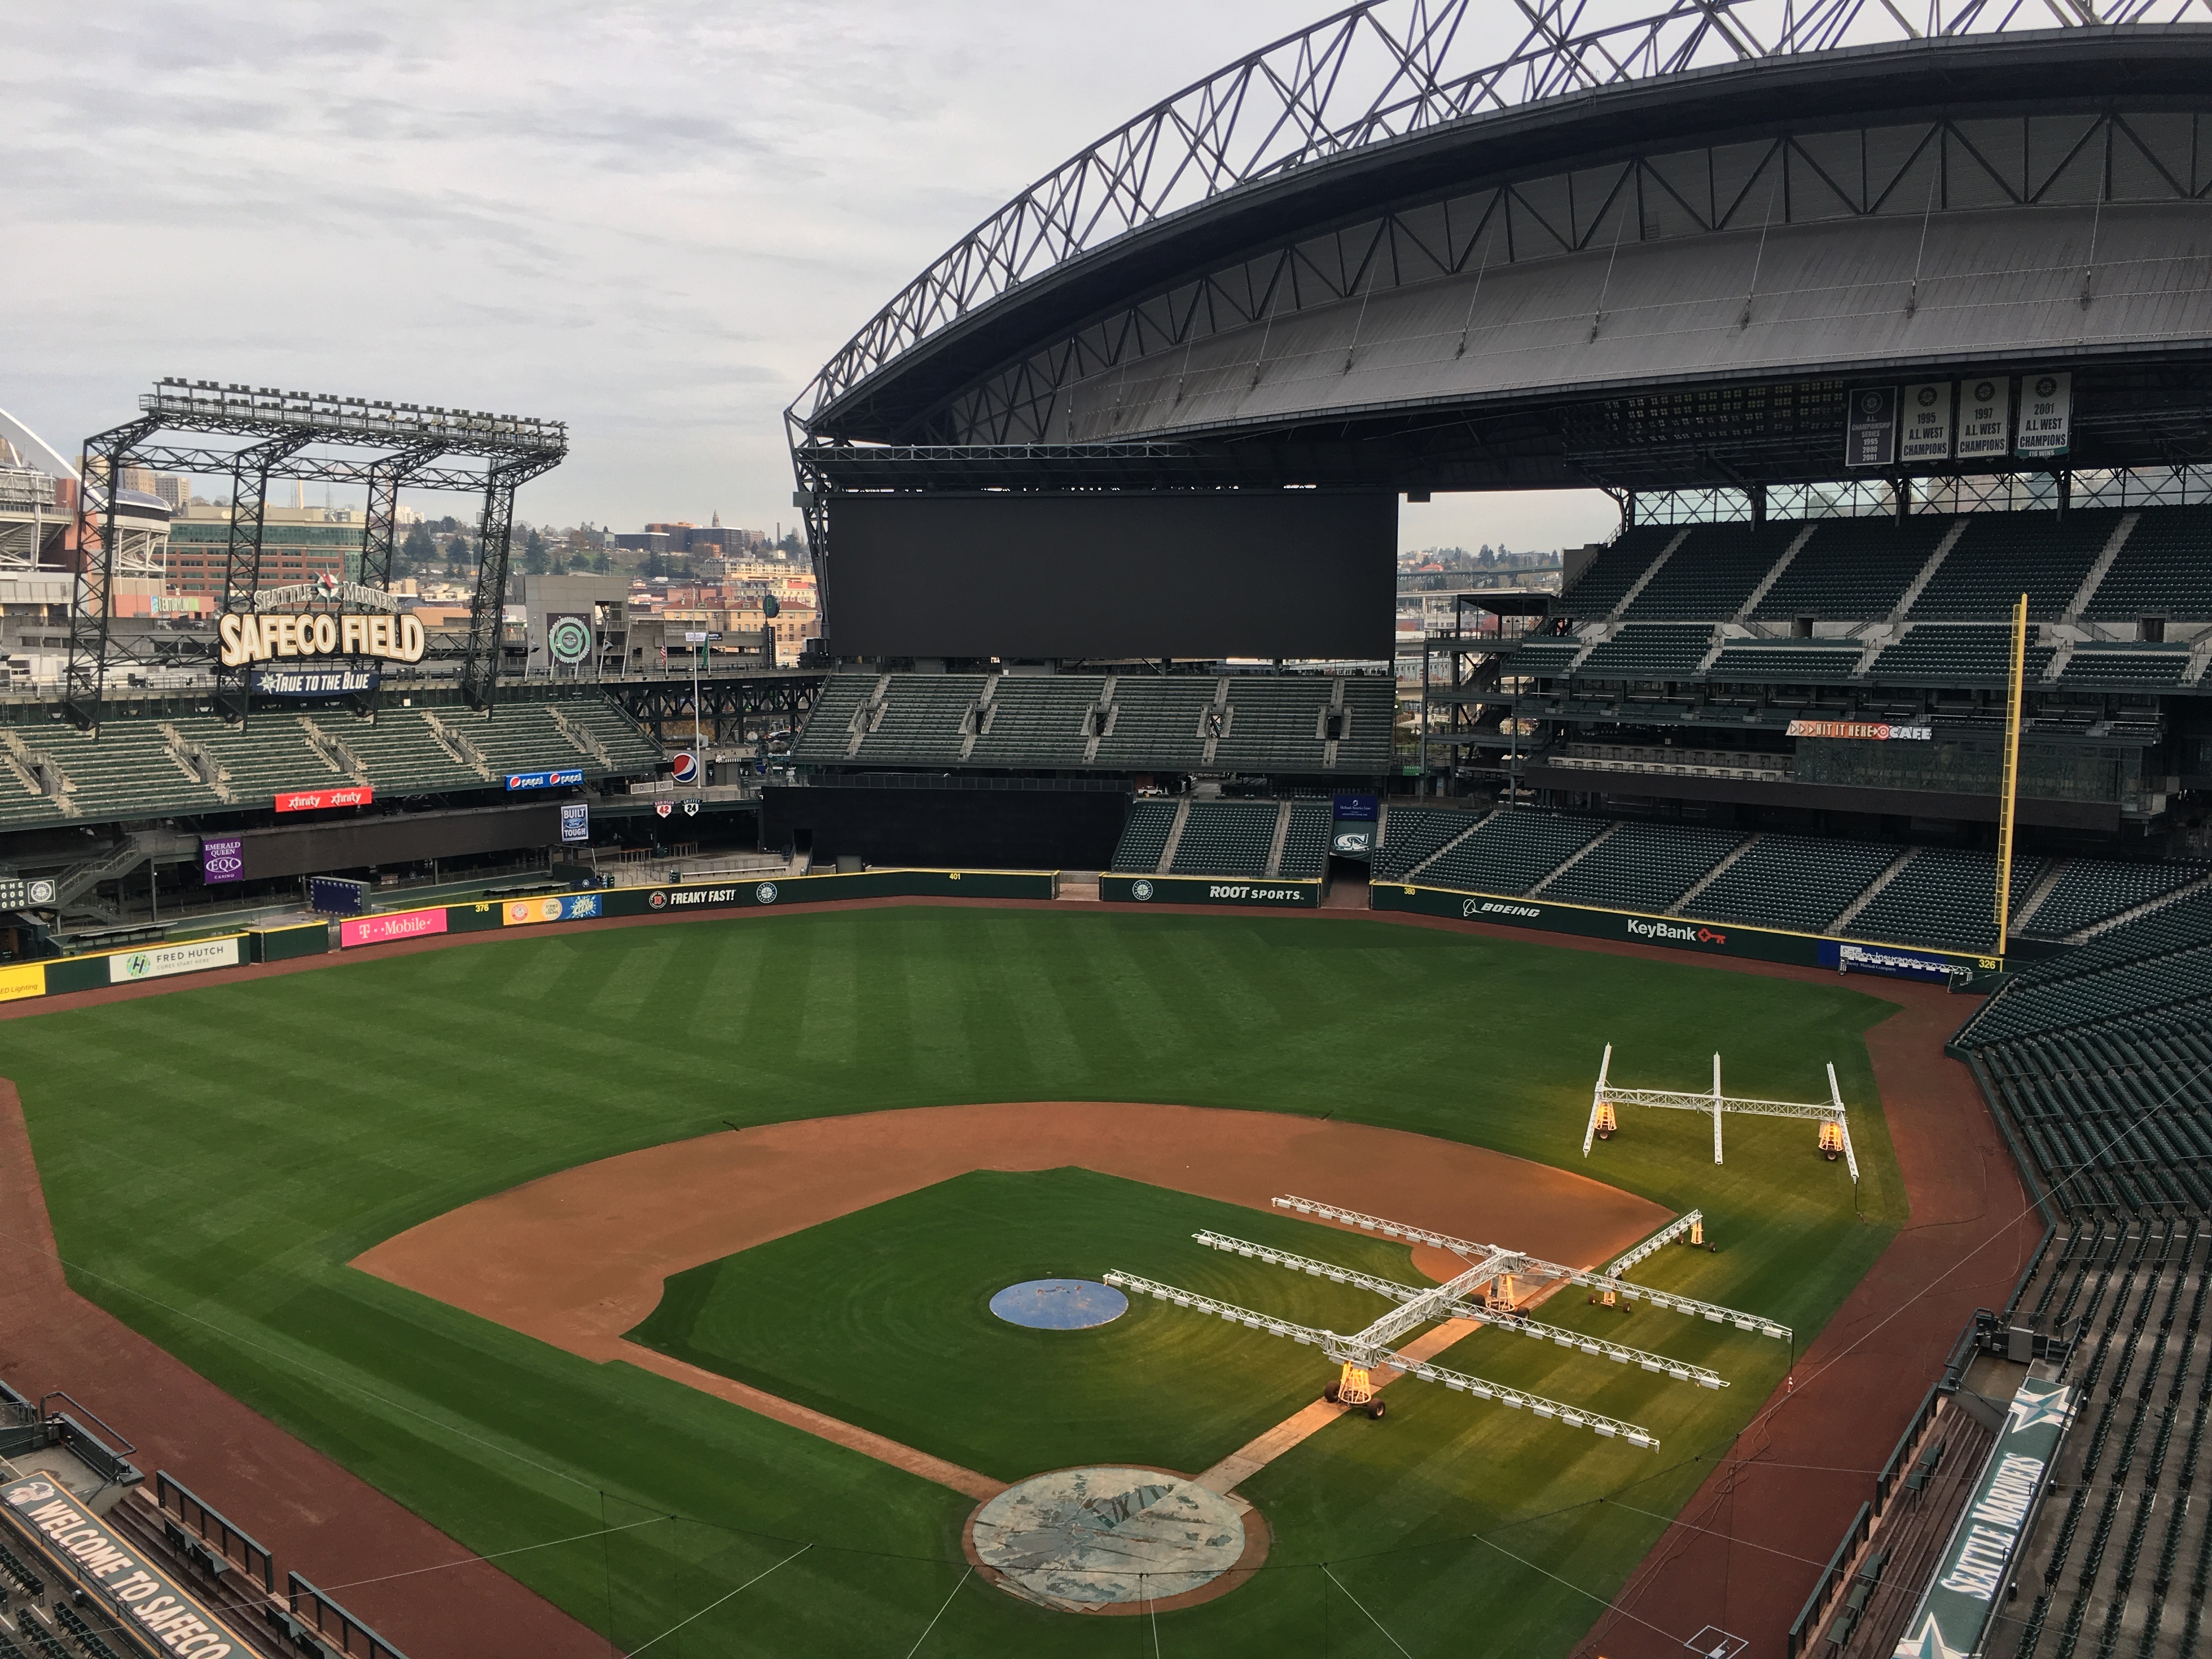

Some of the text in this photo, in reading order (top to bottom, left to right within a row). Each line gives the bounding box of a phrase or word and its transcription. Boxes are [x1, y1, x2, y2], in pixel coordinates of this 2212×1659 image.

[1974, 408, 1993, 420] 1997
[2034, 403, 2055, 415] 2001
[1917, 412, 1936, 424] 1995
[2025, 418, 2062, 431] A.L. WEST
[1852, 422, 1892, 431] CHAMPIONSHIP
[1909, 427, 1944, 439] A.L. WEST
[1966, 422, 2001, 436] A.L. WEST
[1960, 438, 2005, 453] CHAMPIONS
[2019, 434, 2066, 448] CHAMPIONS
[1904, 442, 1947, 456] CHAMPIONS
[254, 581, 398, 613] SEATTLE MARINERS
[220, 613, 425, 667] SAFECO FIELD
[275, 671, 370, 692] TRUE TO THE BLUE
[1816, 723, 1931, 740] HIT IT HERE CAFE
[522, 773, 582, 788] pepsi pepsi
[288, 792, 361, 810] xfinity xfinity
[564, 809, 585, 819] BUILT
[659, 805, 669, 814] 42
[565, 828, 585, 837] TOUGH
[205, 842, 240, 851] EMERALD
[211, 849, 235, 857] QUEEN
[210, 859, 241, 872] EQC
[670, 891, 707, 905] FREAKY
[708, 889, 735, 902] FAST!
[1210, 885, 1300, 900] ROOT SPORTS
[475, 904, 489, 912] 376
[1481, 902, 1541, 917] BOEING
[1628, 919, 1696, 941] KeyBank
[156, 946, 224, 963] FRED HUTCH
[1978, 959, 1996, 969] 326
[11, 984, 38, 992] Lighting
[1939, 1452, 2045, 1601] SEATTLE MARINERS
[28, 1499, 233, 1659] WELCOME TO SAFECO
